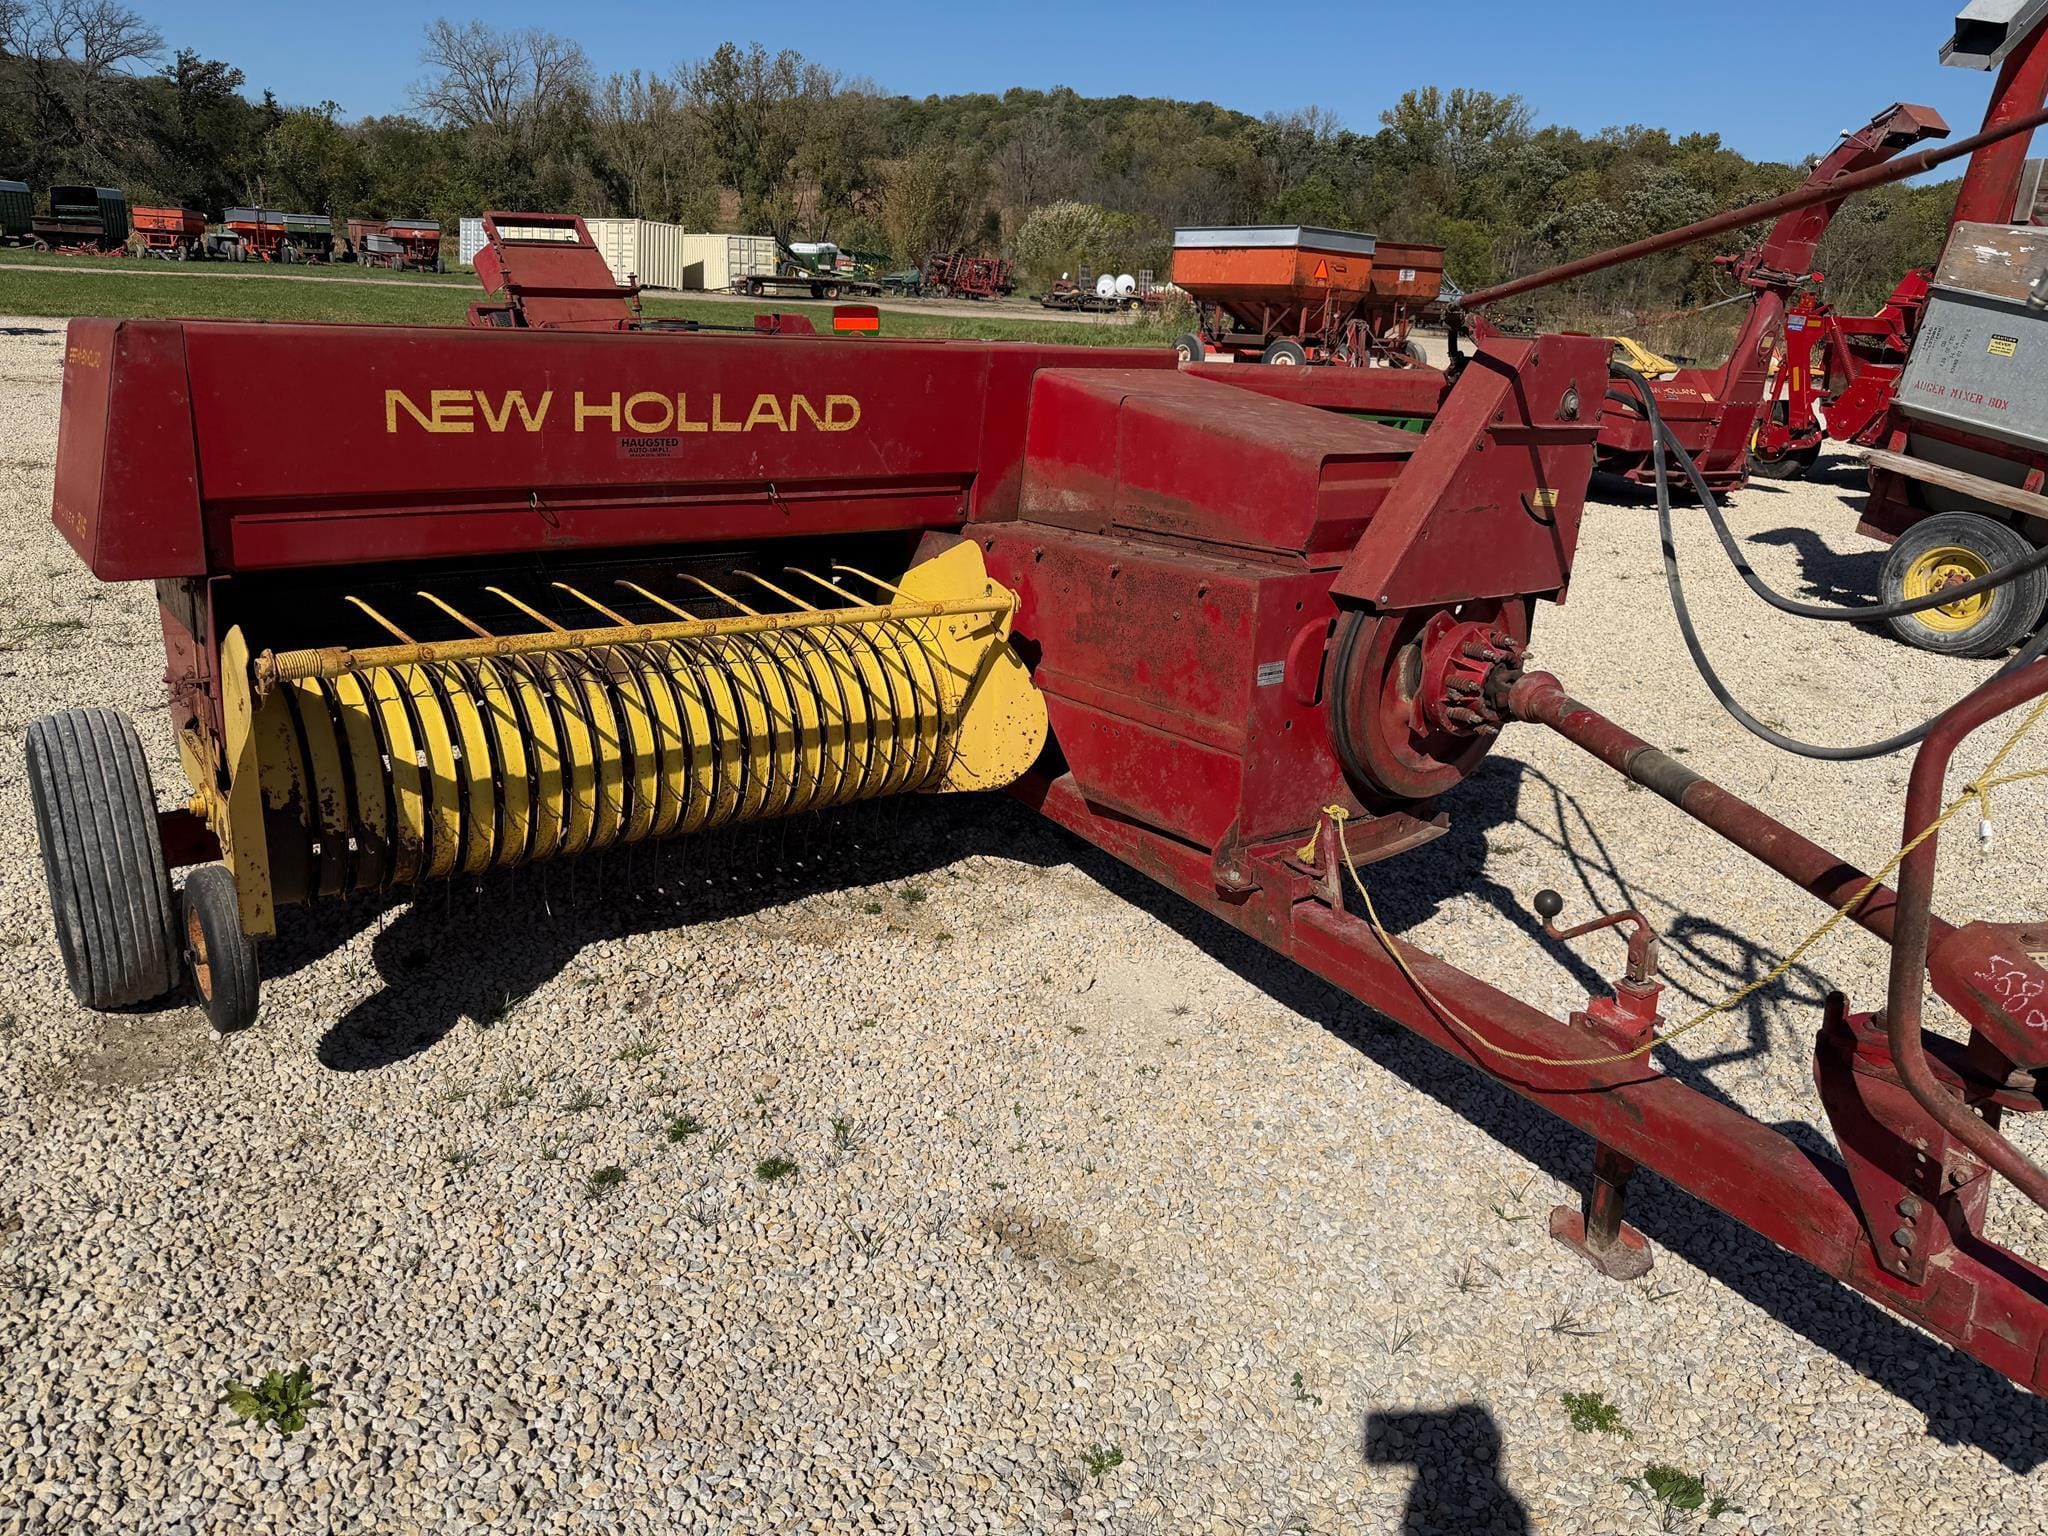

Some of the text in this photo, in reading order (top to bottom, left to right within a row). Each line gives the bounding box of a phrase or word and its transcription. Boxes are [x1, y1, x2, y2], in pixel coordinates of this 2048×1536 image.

[1914, 380, 2009, 410] AUGER MIXER BOX
[385, 389, 861, 434] NEW HOLLAND
[621, 438, 679, 447] HAUGSTED
